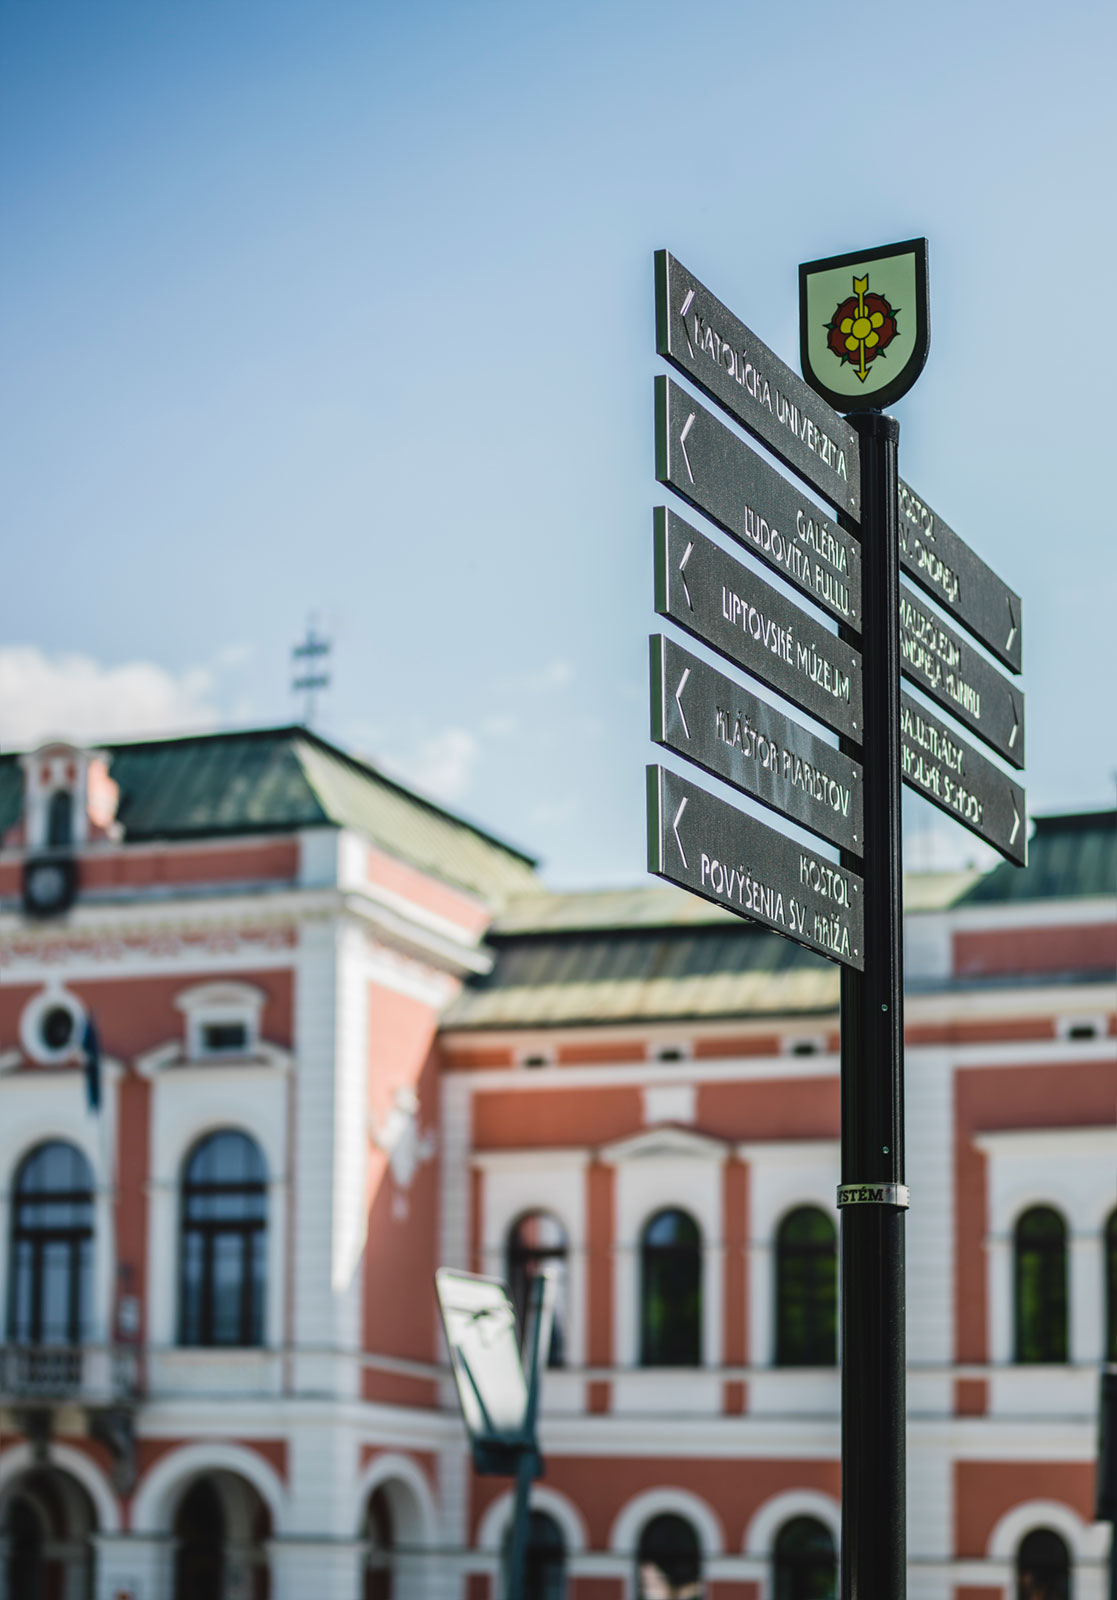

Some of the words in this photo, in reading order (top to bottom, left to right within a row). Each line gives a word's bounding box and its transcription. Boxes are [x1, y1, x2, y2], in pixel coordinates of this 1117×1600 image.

[694, 313, 773, 415] KATOLÍCKA
[776, 390, 847, 481] UNIVERZITA
[745, 505, 813, 586] ĽUDOVÍTA
[815, 564, 850, 616] FULLU
[797, 510, 849, 576] GALÉRIA
[722, 586, 794, 665] LIPTOVSKÉ
[797, 641, 850, 704] MÚZEUM
[716, 706, 779, 774] KLÁŠTOR
[783, 749, 849, 817] PIARISTOV
[701, 853, 786, 925] POVÝŠENIA
[790, 897, 810, 937] SV.
[814, 911, 852, 959] KRÍŽA
[800, 854, 851, 908] KOSTOL
